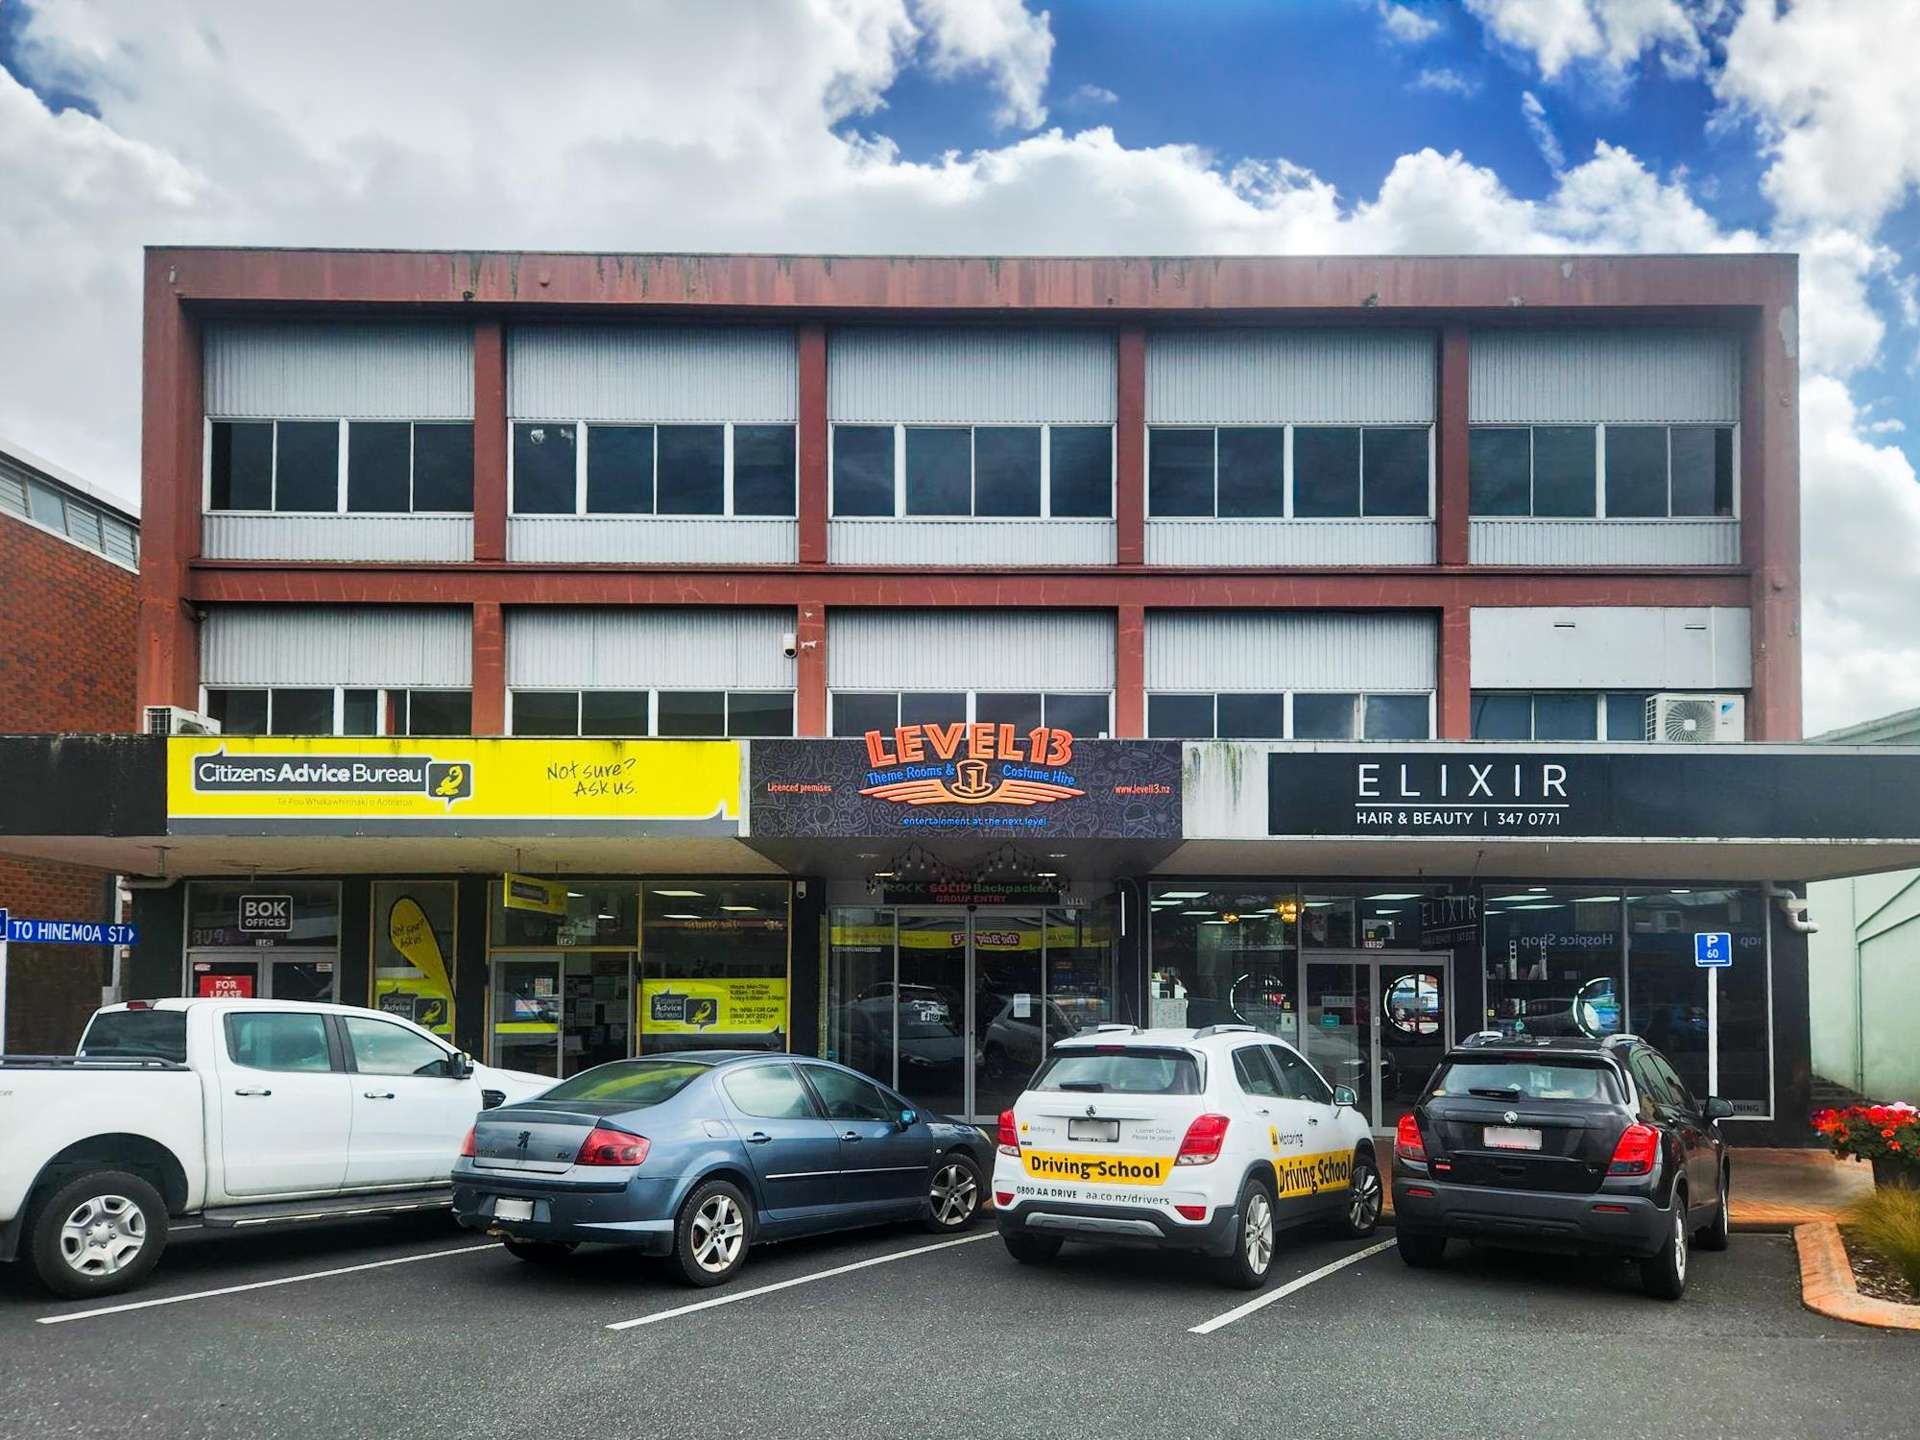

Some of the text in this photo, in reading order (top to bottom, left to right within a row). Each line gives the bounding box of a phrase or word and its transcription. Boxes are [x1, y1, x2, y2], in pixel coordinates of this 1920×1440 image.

[199, 762, 422, 783] Citizens Advice Bureau
[547, 758, 636, 780] Not sure?
[867, 765, 1076, 786] Theme Rooms & Costume Hire
[768, 782, 832, 793] Licenced premises
[1358, 764, 1567, 797] ELIXIR
[903, 817, 1047, 826] entertainment at the next level
[1356, 812, 1560, 825] HAIR & BEAUTY 347 0771
[927, 884, 970, 893] SOLID
[245, 902, 287, 916] BOK
[245, 918, 287, 927] OFFICES
[13, 921, 125, 942] TO HINEMOA ST
[1706, 936, 1718, 948] P
[1706, 949, 1718, 958] 60
[216, 981, 237, 989] FOR
[1279, 1132, 1303, 1148] Motoring
[1031, 1155, 1160, 1179] Driving School
[1279, 1154, 1351, 1193] Driving School
[1016, 1185, 1035, 1194] 0800
[1037, 1187, 1049, 1195] AA
[1051, 1188, 1077, 1199] DRIVE
